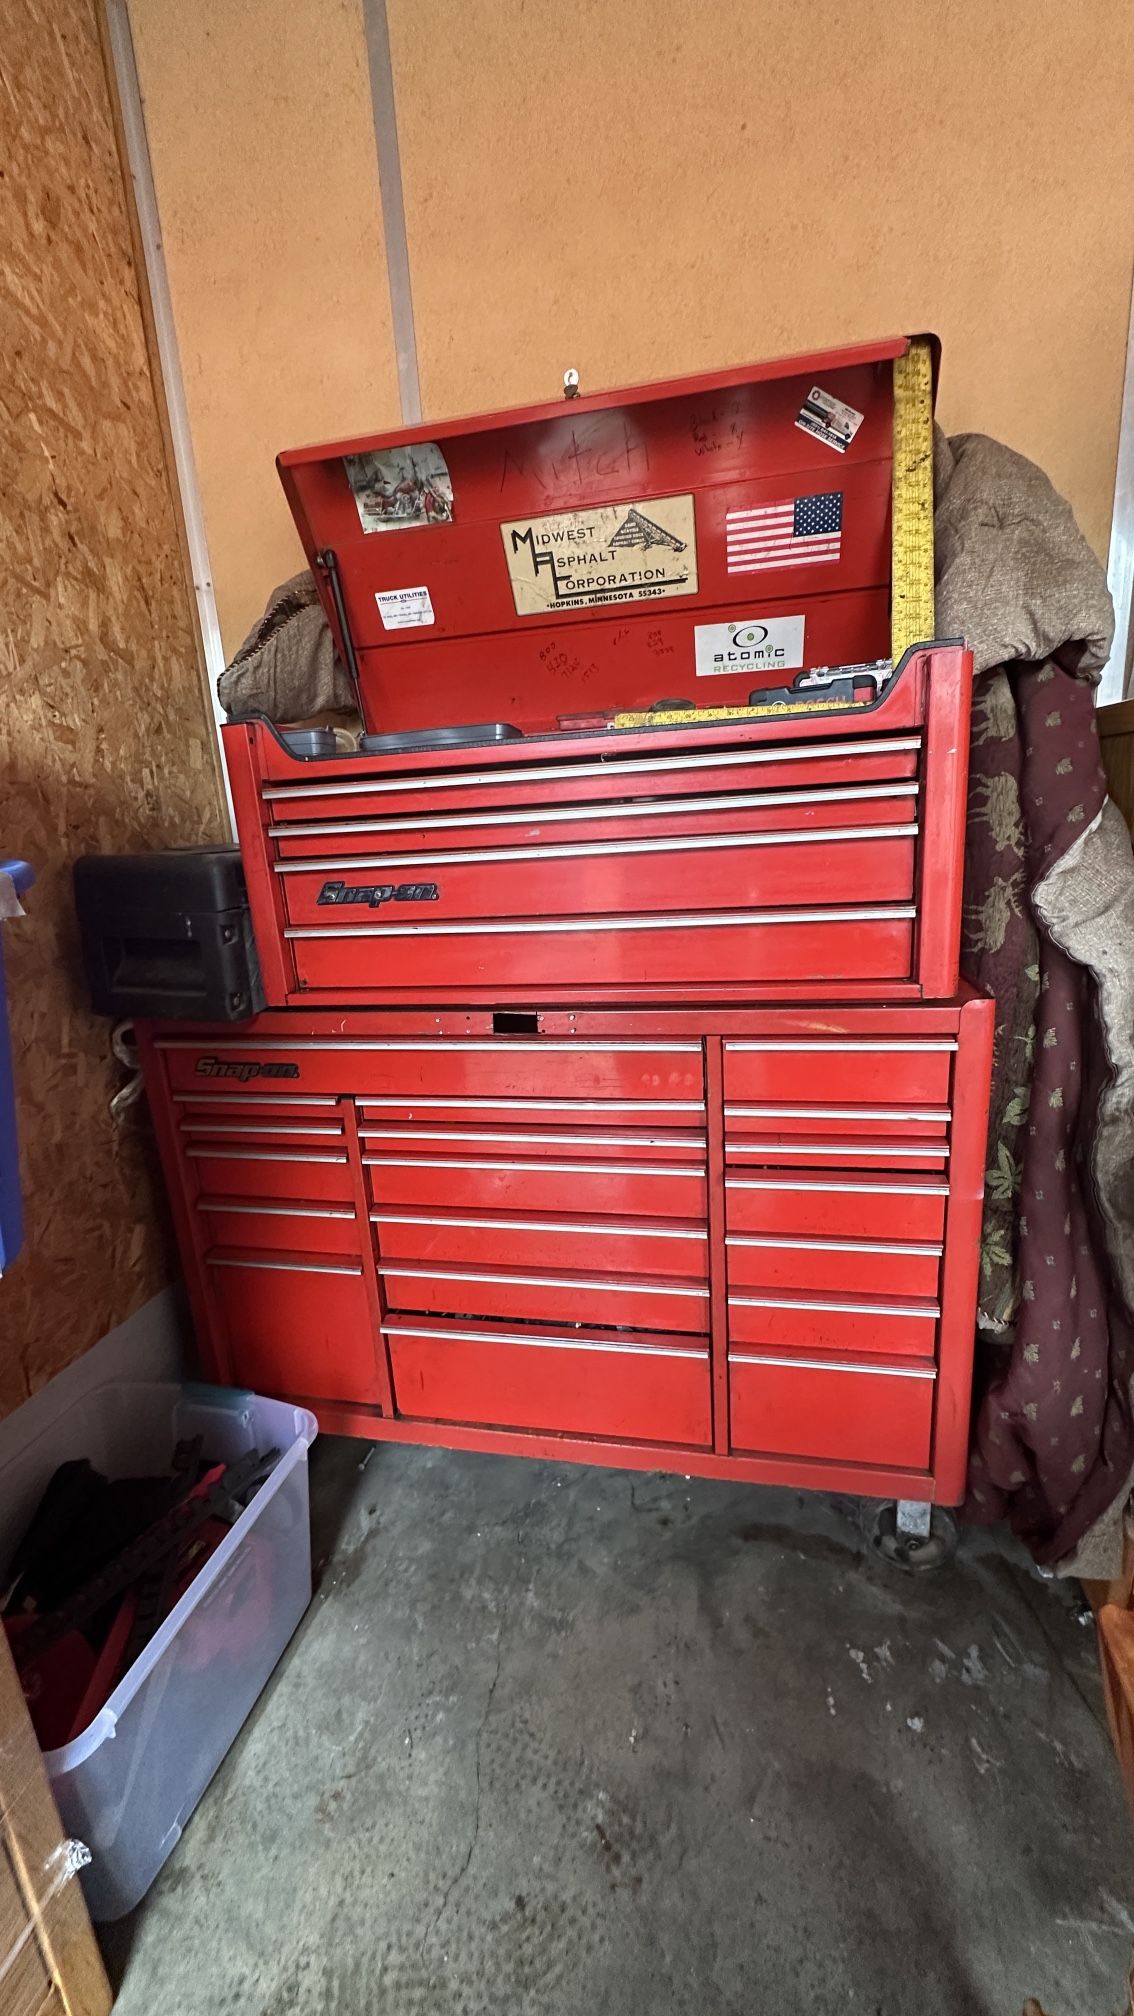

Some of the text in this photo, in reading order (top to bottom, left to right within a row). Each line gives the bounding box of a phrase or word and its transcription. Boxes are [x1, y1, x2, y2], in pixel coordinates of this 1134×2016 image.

[511, 526, 596, 554] MIDWEST
[533, 550, 618, 577] ASPHALT
[378, 590, 427, 603] TRUCK UTILITIES
[554, 568, 677, 600] CORPORATION
[588, 592, 634, 604] MINNESOTA
[713, 646, 785, 663] atomic
[713, 660, 785, 673] RECYCLING
[317, 881, 439, 908] Snap-on
[195, 1056, 300, 1082] Snap-on
